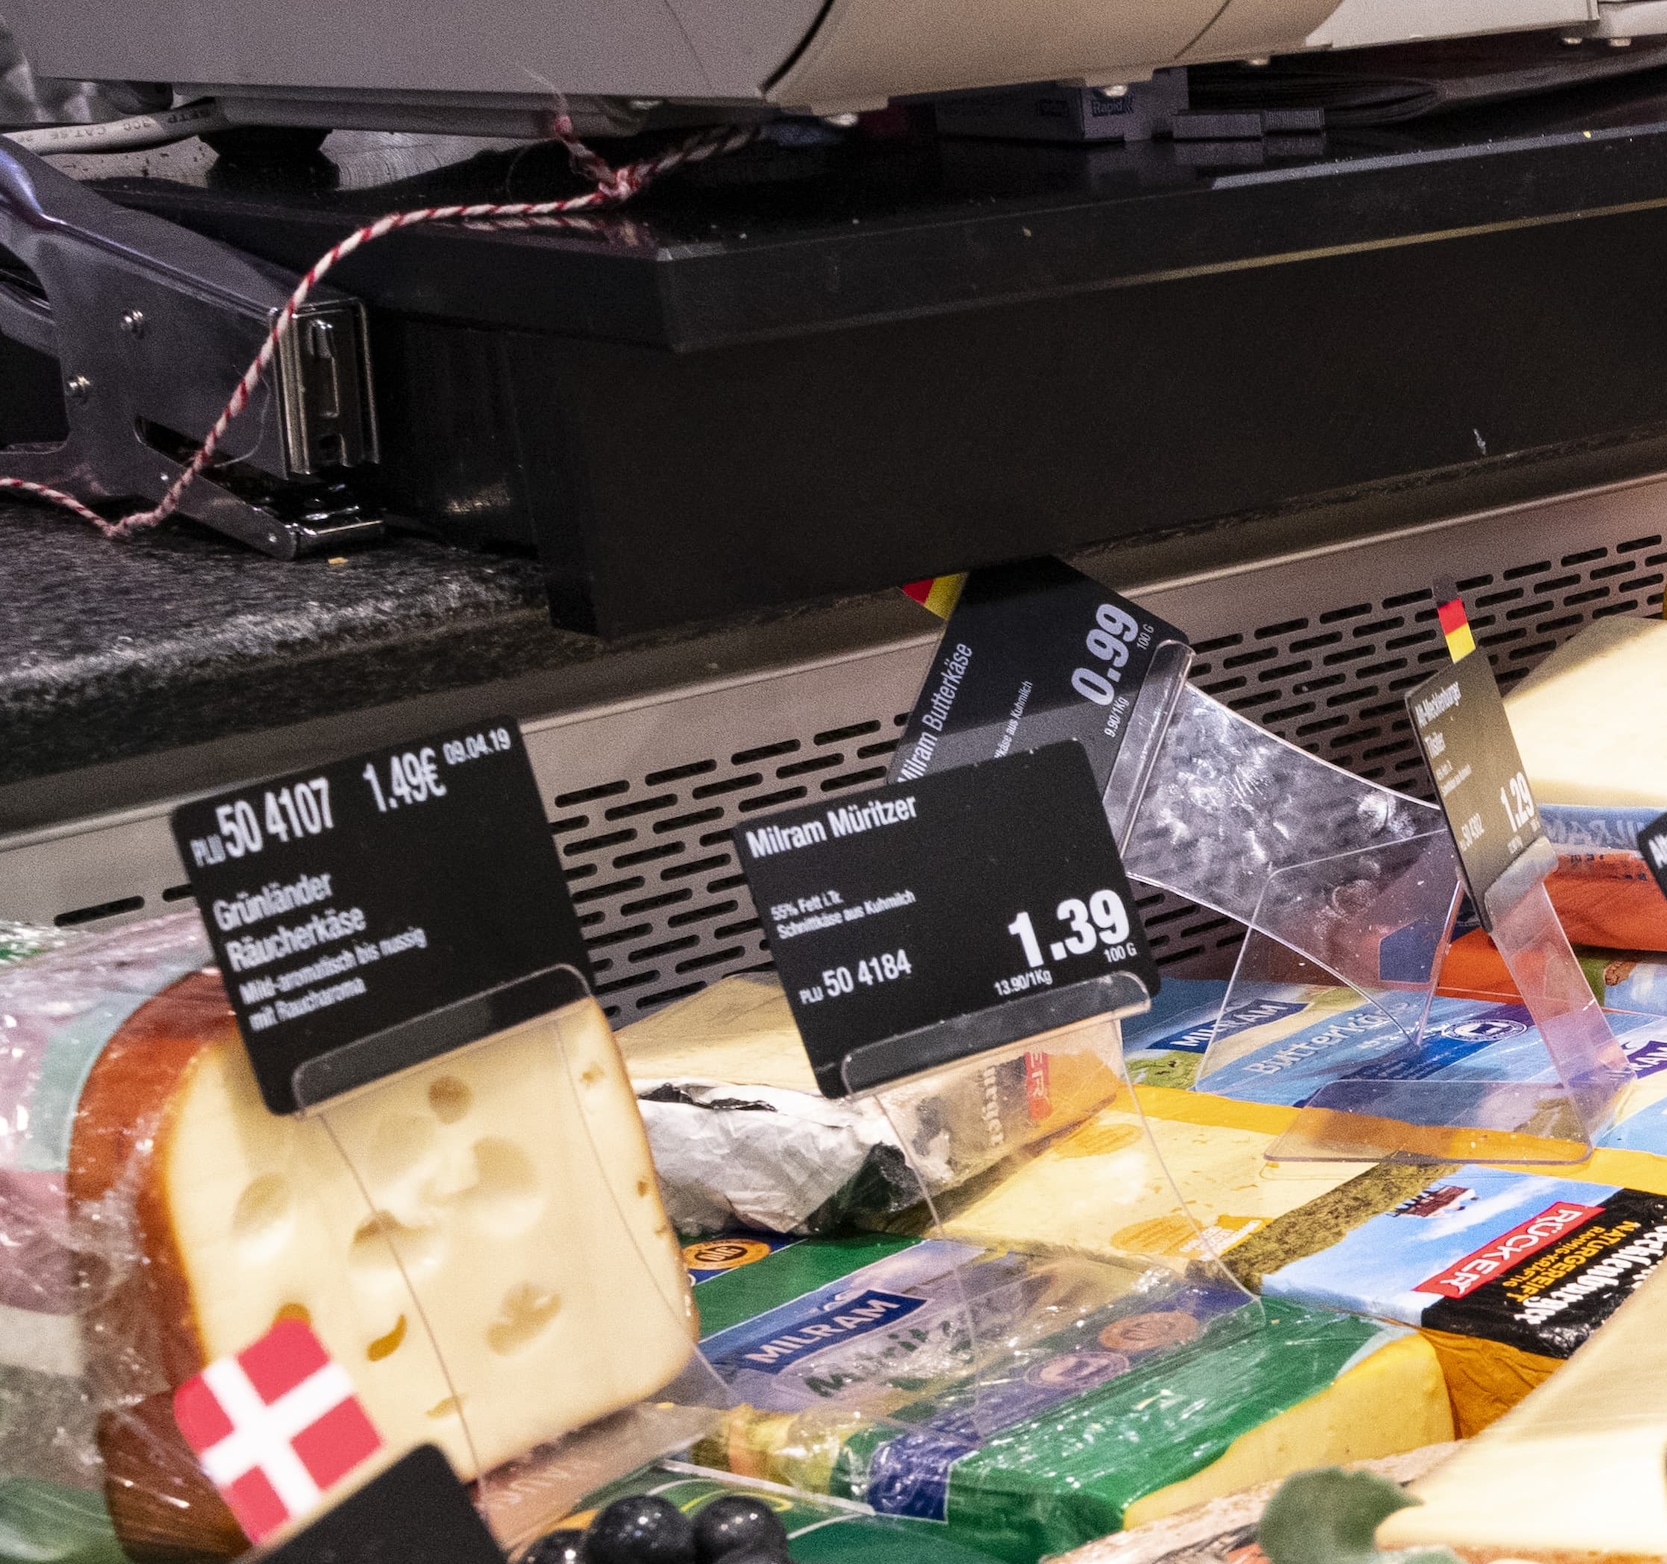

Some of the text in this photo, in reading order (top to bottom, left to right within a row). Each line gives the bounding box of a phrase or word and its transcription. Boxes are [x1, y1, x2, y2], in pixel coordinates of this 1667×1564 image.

[1071, 603, 1139, 706] 0.99
[1137, 634, 1149, 650] 100
[922, 642, 973, 732] Butterkäse
[1009, 680, 1033, 721] Kuhmilch
[1104, 696, 1130, 738] 9.90/1Kg
[190, 728, 512, 868] PLU 50 4107 1.49€ 09.04.19
[746, 796, 918, 858] Milram Müritzer
[1500, 770, 1535, 833] 1.29
[212, 872, 334, 932] Grünländer
[771, 900, 799, 921] 55%
[798, 893, 824, 914] Fett
[777, 889, 917, 940] Schnittkäse aus Kuhmilch
[1008, 889, 1131, 969] 1.39
[226, 906, 367, 972] Räucherkäse
[1104, 942, 1138, 964] 100 G
[799, 948, 913, 1006] PLU 50 4184
[994, 968, 1054, 997] 13.90/1Kg
[1433, 1208, 1586, 1295] RÜCKER
[1502, 1225, 1606, 1289] RAHMIG-KRÄFTIG
[1513, 1220, 1641, 1302] NATURGEREIFT
[743, 1298, 902, 1364] MILRAM
